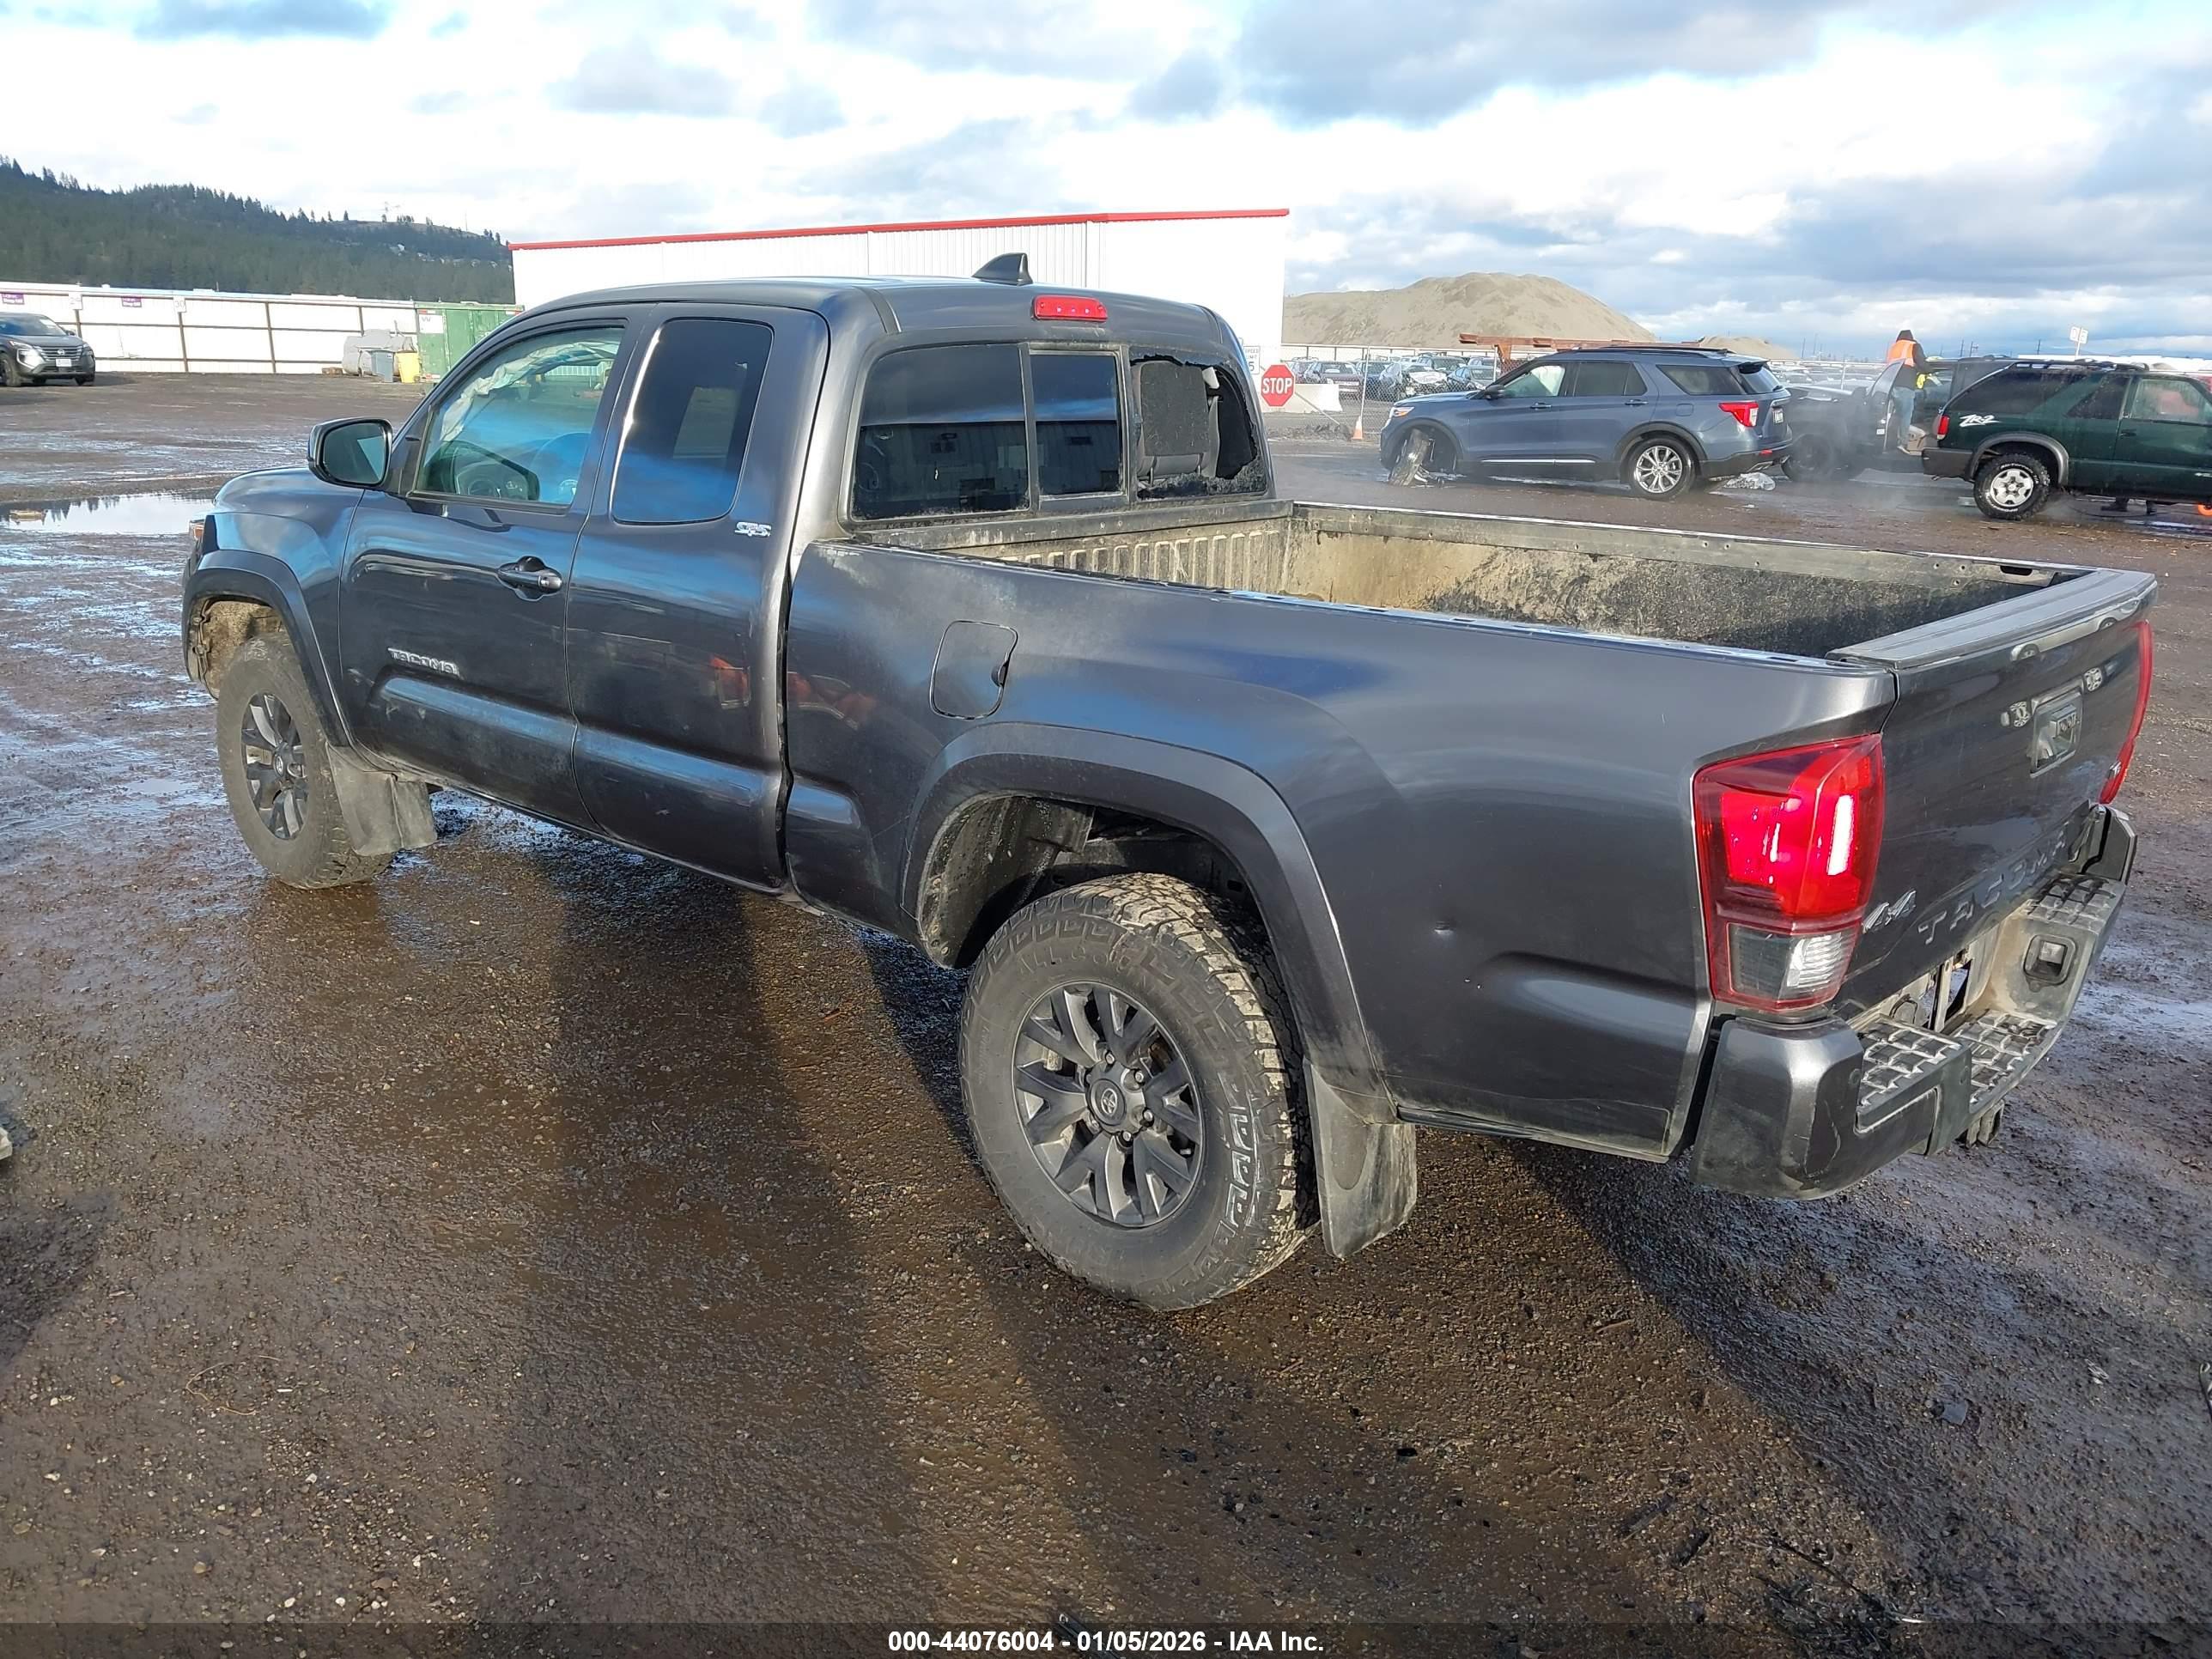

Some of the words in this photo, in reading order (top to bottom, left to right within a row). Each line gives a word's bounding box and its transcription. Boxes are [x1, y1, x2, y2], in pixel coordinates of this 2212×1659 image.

[1262, 377, 1293, 395] STOP
[387, 647, 465, 681] TACOMA
[1917, 820, 2069, 945] TACOMA
